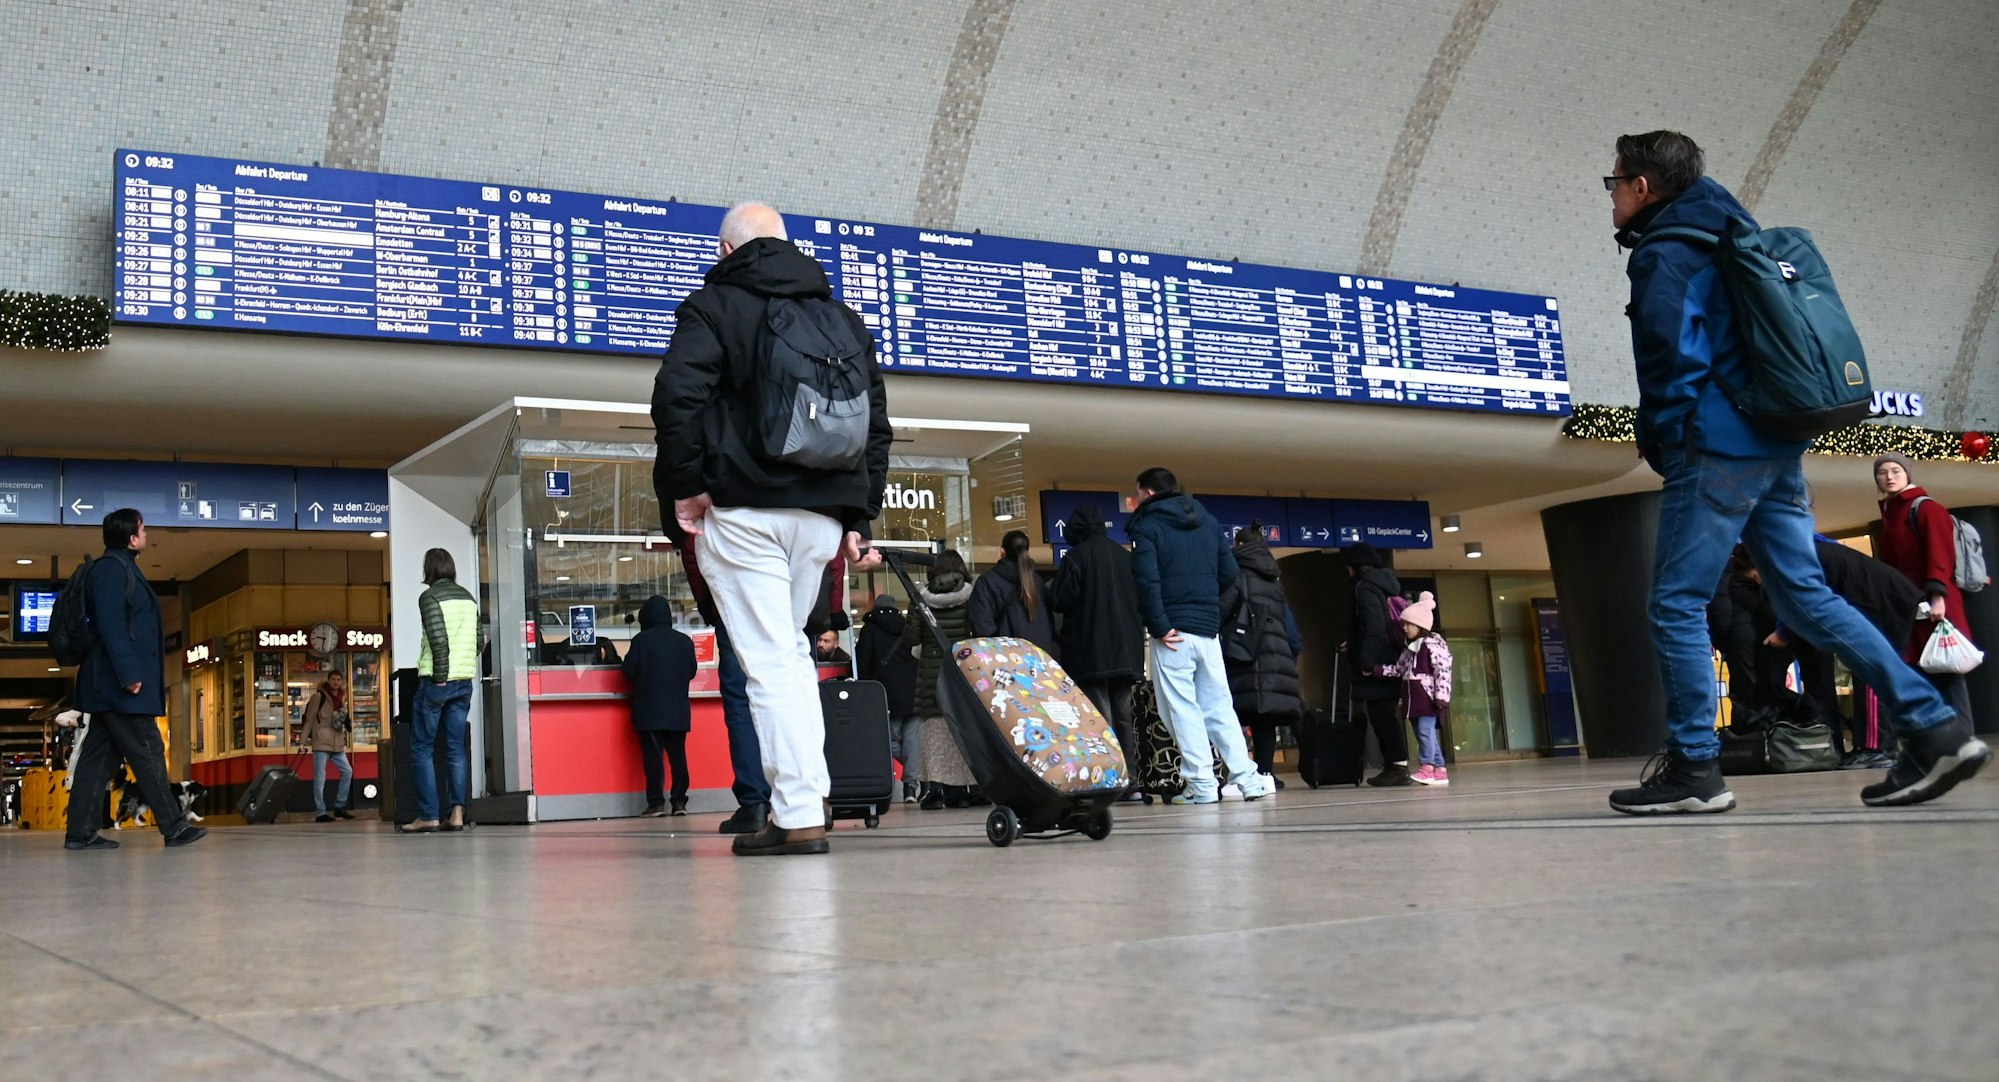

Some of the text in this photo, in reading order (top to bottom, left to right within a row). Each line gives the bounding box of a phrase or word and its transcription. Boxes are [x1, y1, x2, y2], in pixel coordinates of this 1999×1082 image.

[145, 156, 173, 168] 09:32
[235, 165, 307, 181] Abfahrt Departure
[125, 186, 149, 197] 08:11
[527, 192, 550, 203] 09:32
[125, 202, 148, 212] 08:41
[604, 200, 666, 215] Abfahrt Departure
[375, 208, 430, 221] Hamburg-Altona
[125, 216, 148, 227] 09:21
[469, 216, 474, 225] 5
[510, 220, 531, 230] 09:31
[375, 223, 444, 236] Amsterdam Centraal
[469, 230, 474, 239] 5
[376, 236, 413, 248] Emsdetten
[511, 234, 531, 244] 09:32
[124, 245, 148, 256] 09:26
[457, 243, 476, 253] 2 A-C
[511, 248, 532, 257] 09:34
[376, 251, 428, 263] W-Oberbarmen
[470, 258, 475, 266] 1
[124, 260, 148, 270] 09:27
[512, 261, 532, 271] 09:37
[376, 264, 438, 277] Berlin Ostbahnhof
[458, 271, 476, 280] 4 A-C
[512, 275, 532, 284] 09:37
[376, 279, 438, 291] Bergisch Gladbach
[458, 285, 481, 294] 10 A-B
[124, 290, 148, 300] 09:29
[513, 289, 533, 298] 09:37
[471, 300, 476, 308] 6
[513, 302, 534, 312] 09:38
[124, 305, 148, 315] 09:30
[377, 307, 406, 319] Bedburg
[513, 316, 534, 326] 09:38
[460, 327, 469, 336] 11
[514, 330, 534, 340] 09:40
[882, 483, 935, 510] tion
[346, 502, 362, 512] den
[332, 514, 382, 524] koelnmesse
[1376, 528, 1412, 536] GepäckCenter
[259, 630, 384, 648] Snack Stop
